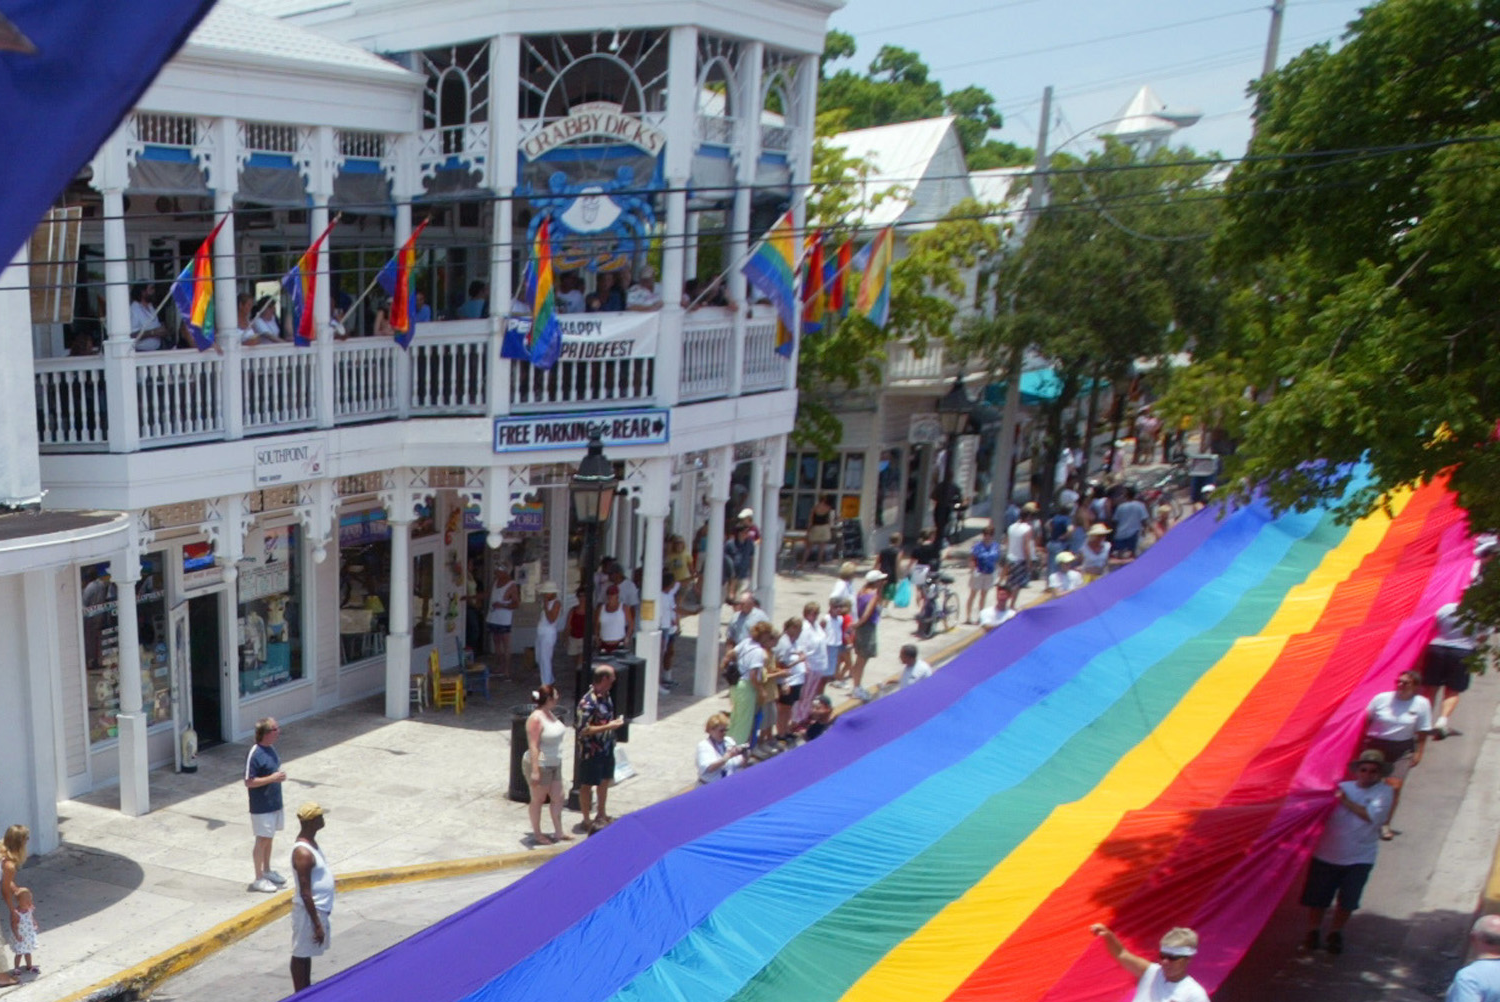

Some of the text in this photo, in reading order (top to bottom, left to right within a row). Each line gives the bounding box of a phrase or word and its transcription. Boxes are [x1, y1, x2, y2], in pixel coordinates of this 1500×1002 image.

[525, 114, 602, 156] CRABBY
[560, 320, 602, 335] HAPPY
[560, 340, 636, 359] PRIDEFEST
[499, 424, 531, 445] FREE
[534, 420, 596, 443] PARKING
[612, 417, 651, 439] REAR
[257, 446, 308, 465] SOUTHPOINT
